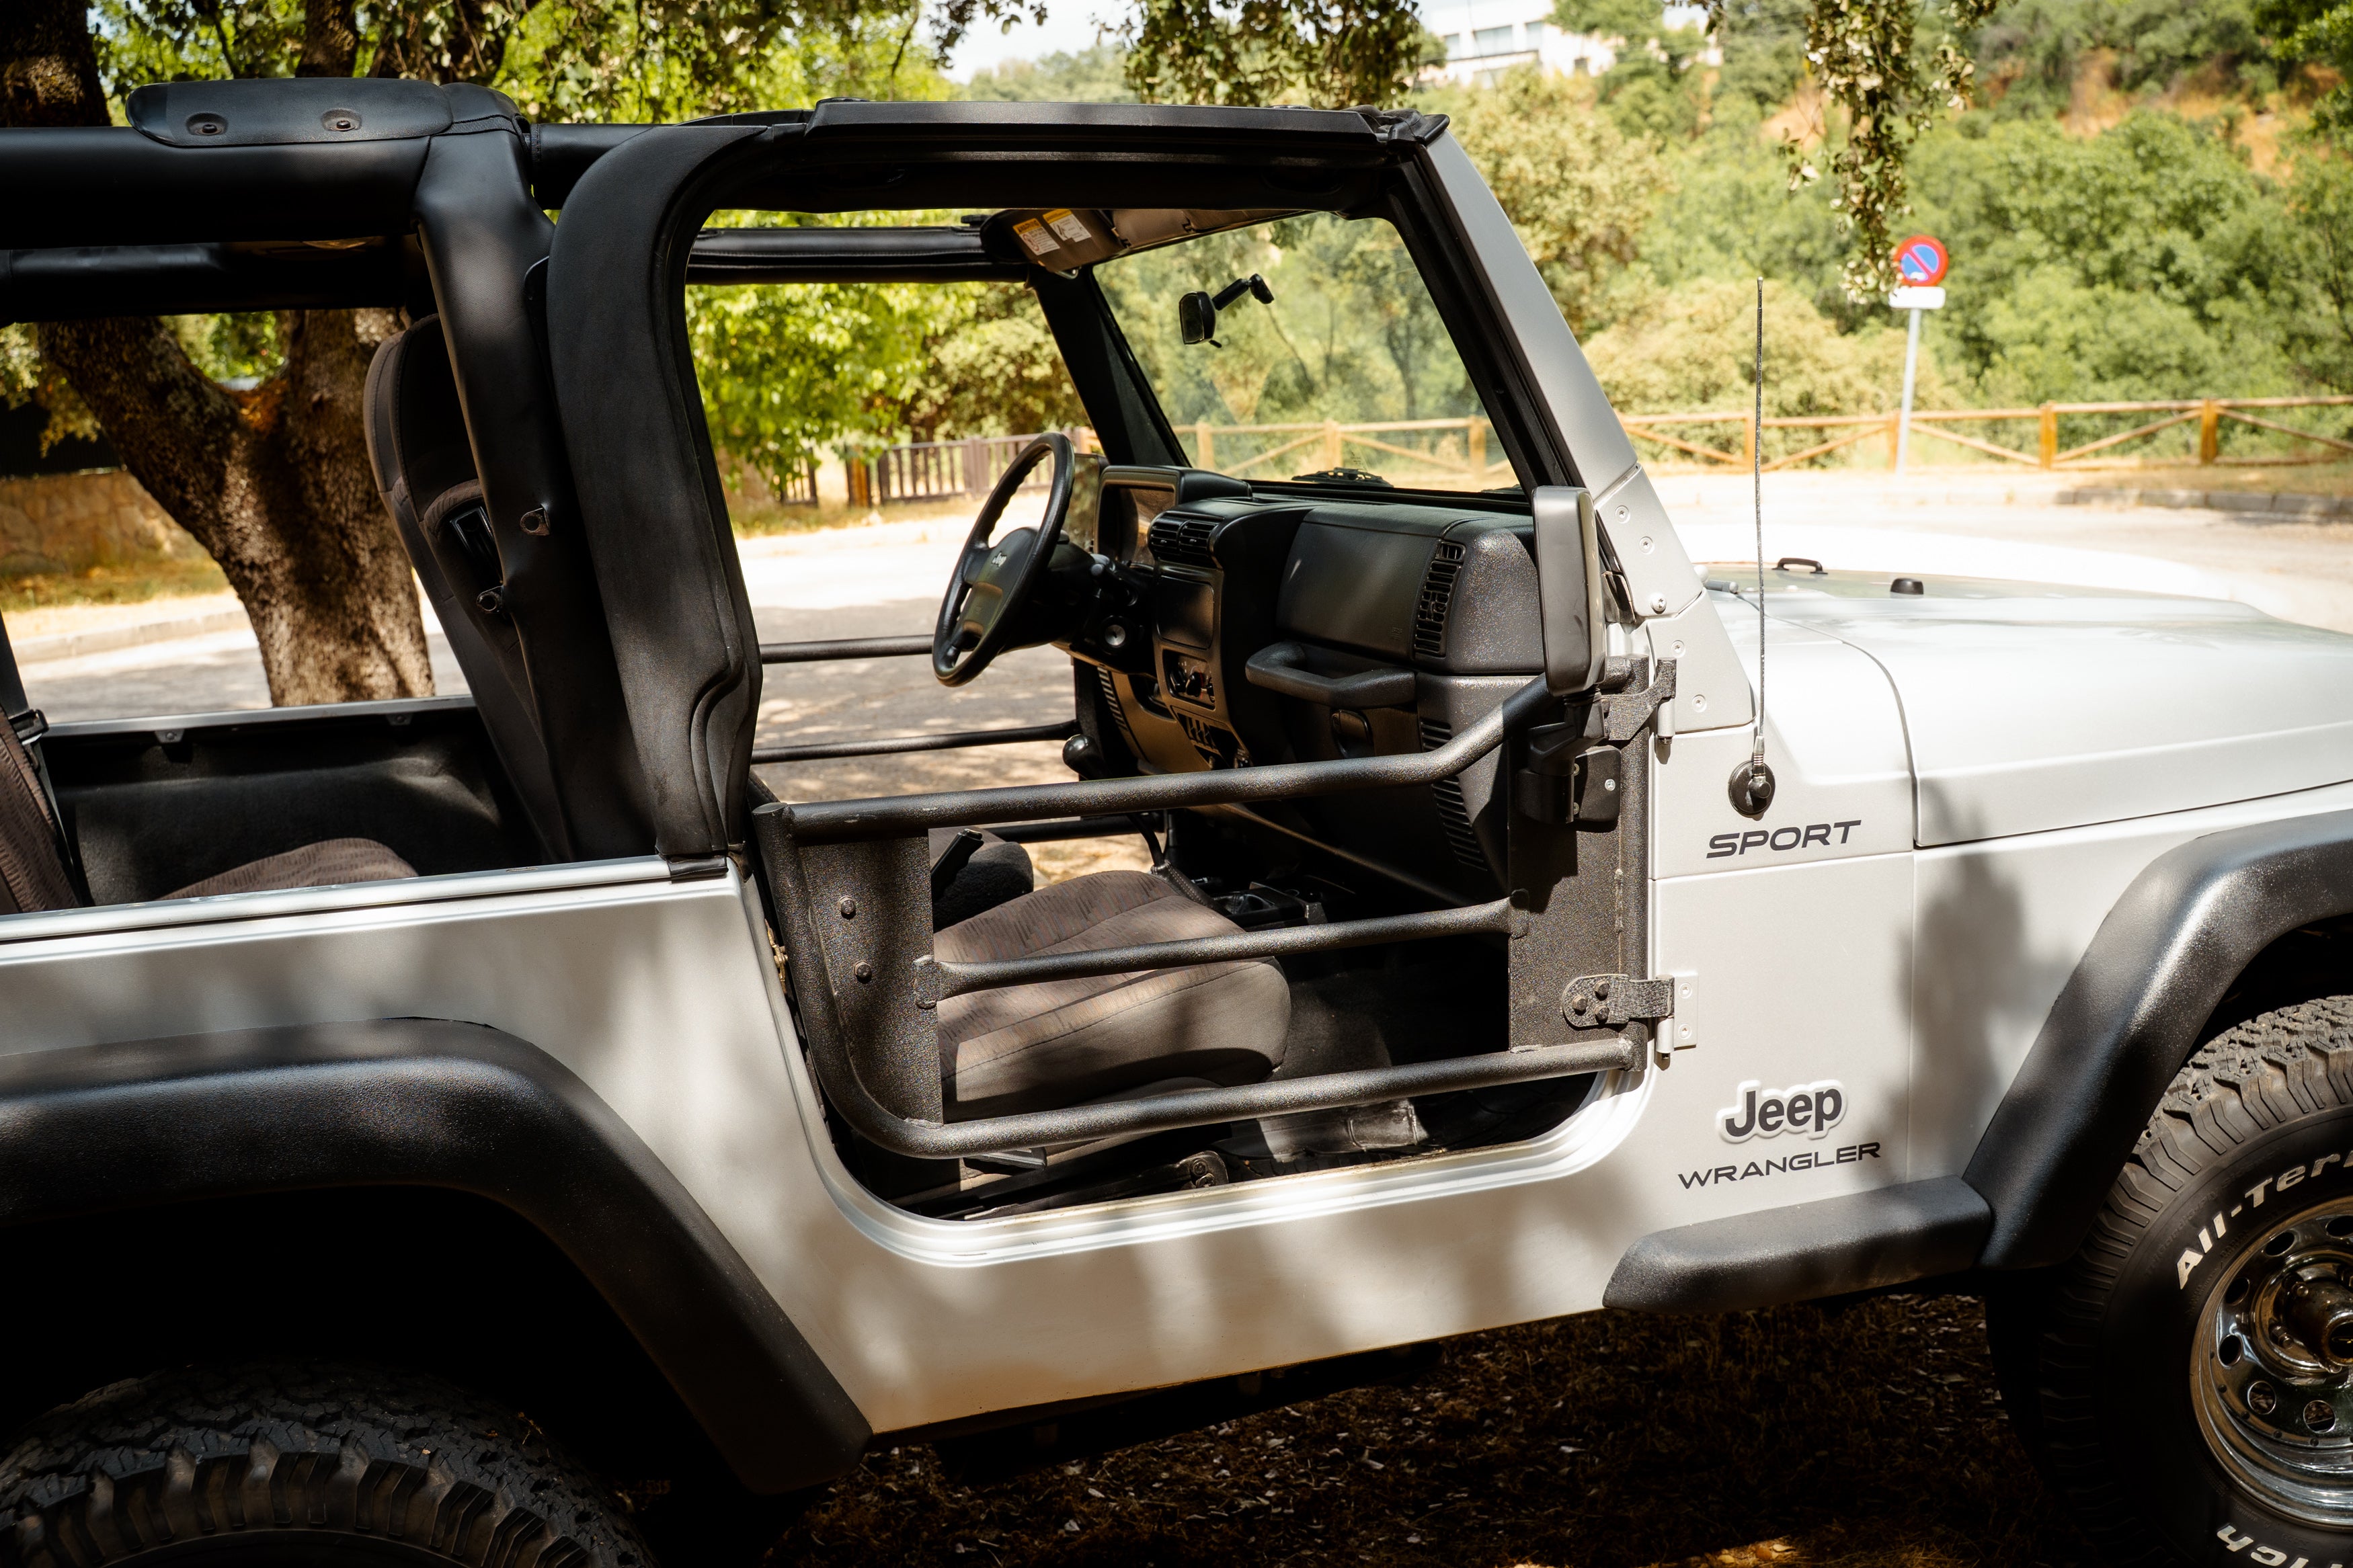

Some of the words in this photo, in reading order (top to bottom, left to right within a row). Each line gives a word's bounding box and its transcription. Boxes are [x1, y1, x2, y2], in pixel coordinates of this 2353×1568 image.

[1706, 819, 1862, 859] SPORT
[1724, 1087, 1843, 1137] Jeep
[1677, 1141, 1881, 1190] WRANGLER
